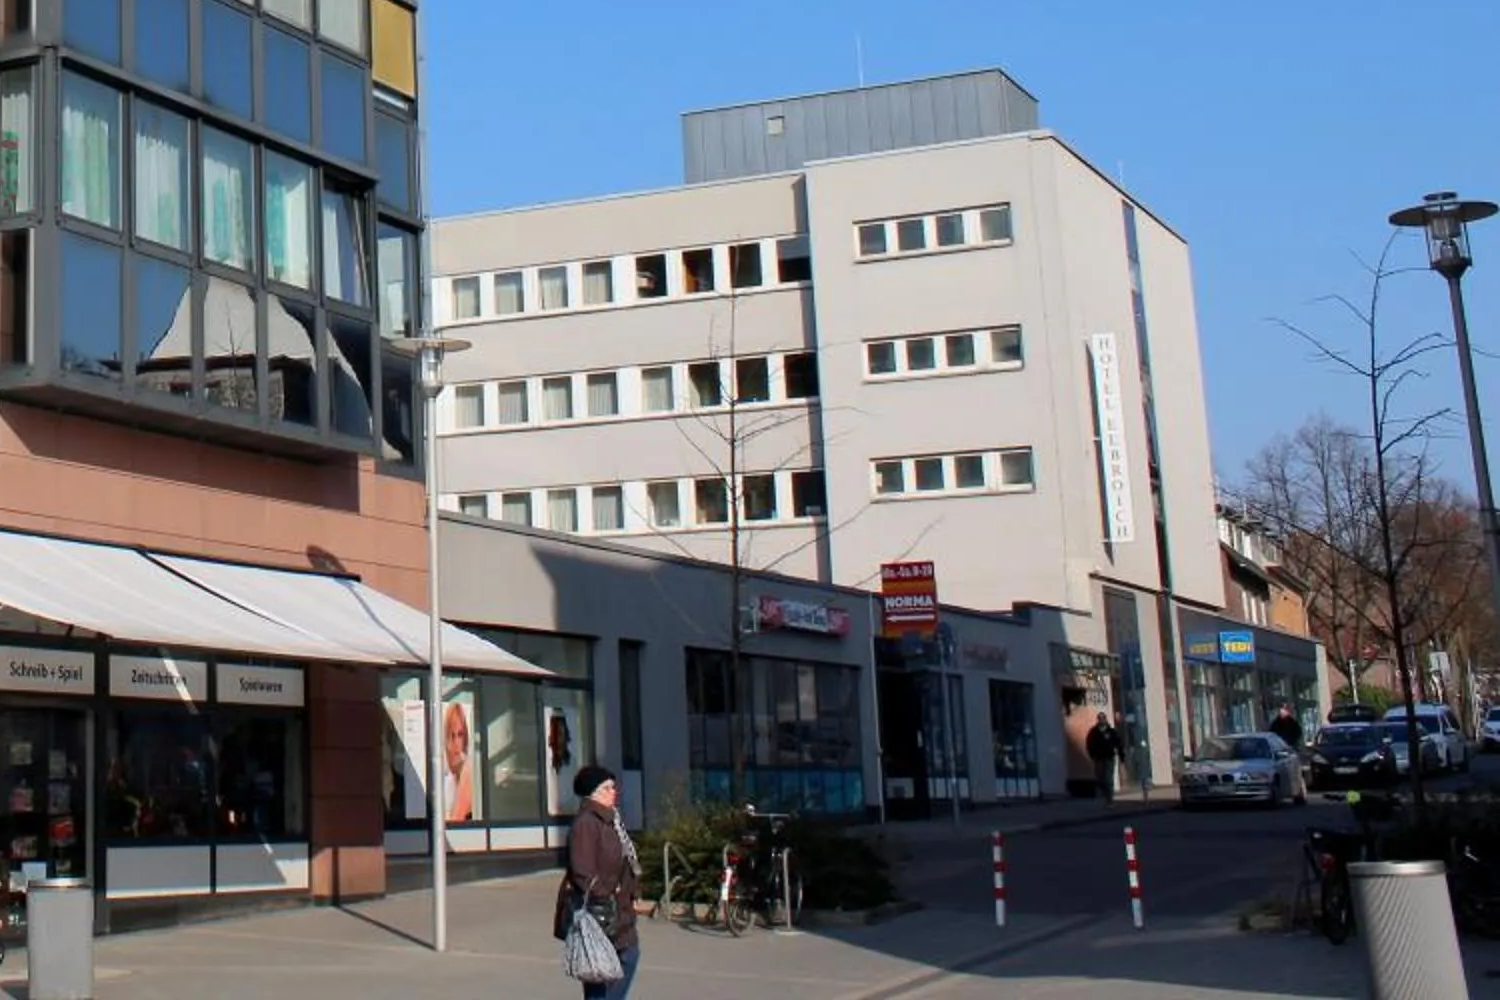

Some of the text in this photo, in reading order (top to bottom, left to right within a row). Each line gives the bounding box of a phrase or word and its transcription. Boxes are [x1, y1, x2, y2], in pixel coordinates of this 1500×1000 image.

[1099, 336, 1128, 538] HOTEL ELBROICH
[885, 595, 933, 609] NORMA
[9, 660, 48, 679] Schreib
[58, 666, 83, 682] Spiel
